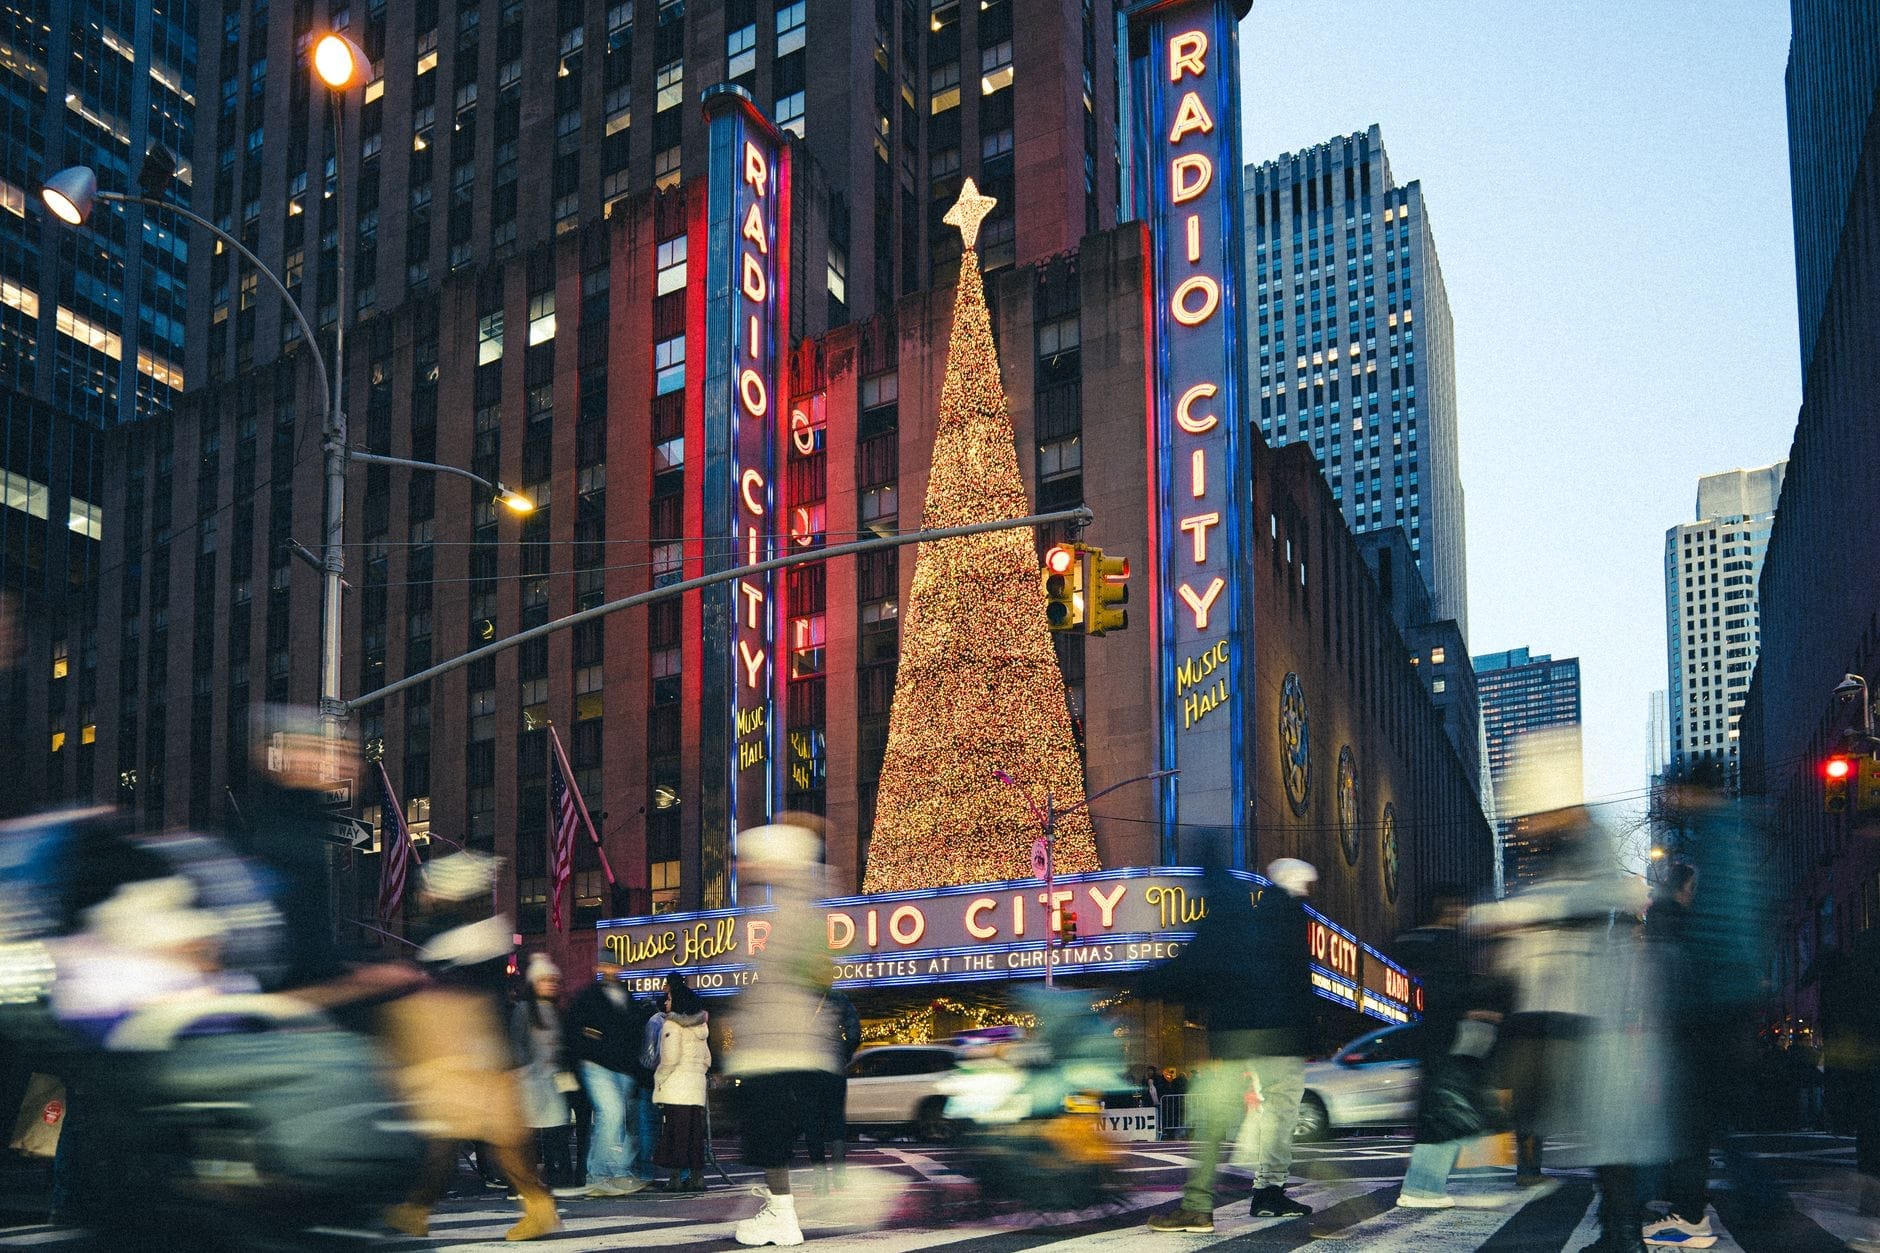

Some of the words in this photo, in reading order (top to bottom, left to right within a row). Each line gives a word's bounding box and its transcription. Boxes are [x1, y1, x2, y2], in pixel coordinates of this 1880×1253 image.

[1171, 30, 1219, 326] RADIO
[740, 140, 767, 417] RADIO
[1176, 383, 1225, 630] CITY
[739, 469, 765, 689] CITY
[1177, 639, 1228, 697] MUSIC
[737, 705, 764, 739] MUSIC
[1184, 679, 1229, 730] HALL
[740, 740, 764, 772] HALL
[326, 788, 345, 802] WAY
[338, 823, 360, 840] WAY
[606, 931, 675, 966] Music
[672, 916, 737, 966] Hall
[747, 904, 925, 957] RDIO
[965, 884, 1127, 939] CITY
[696, 974, 723, 988] 100
[733, 971, 759, 985] YEA
[832, 960, 917, 979] OCKETTES
[929, 957, 950, 973] AT
[964, 954, 995, 971] THE
[1007, 945, 1113, 969] CHRISTMAS
[1330, 933, 1357, 976] CITY
[1384, 967, 1410, 1005] RADIO
[1096, 1115, 1147, 1132] NYPD
